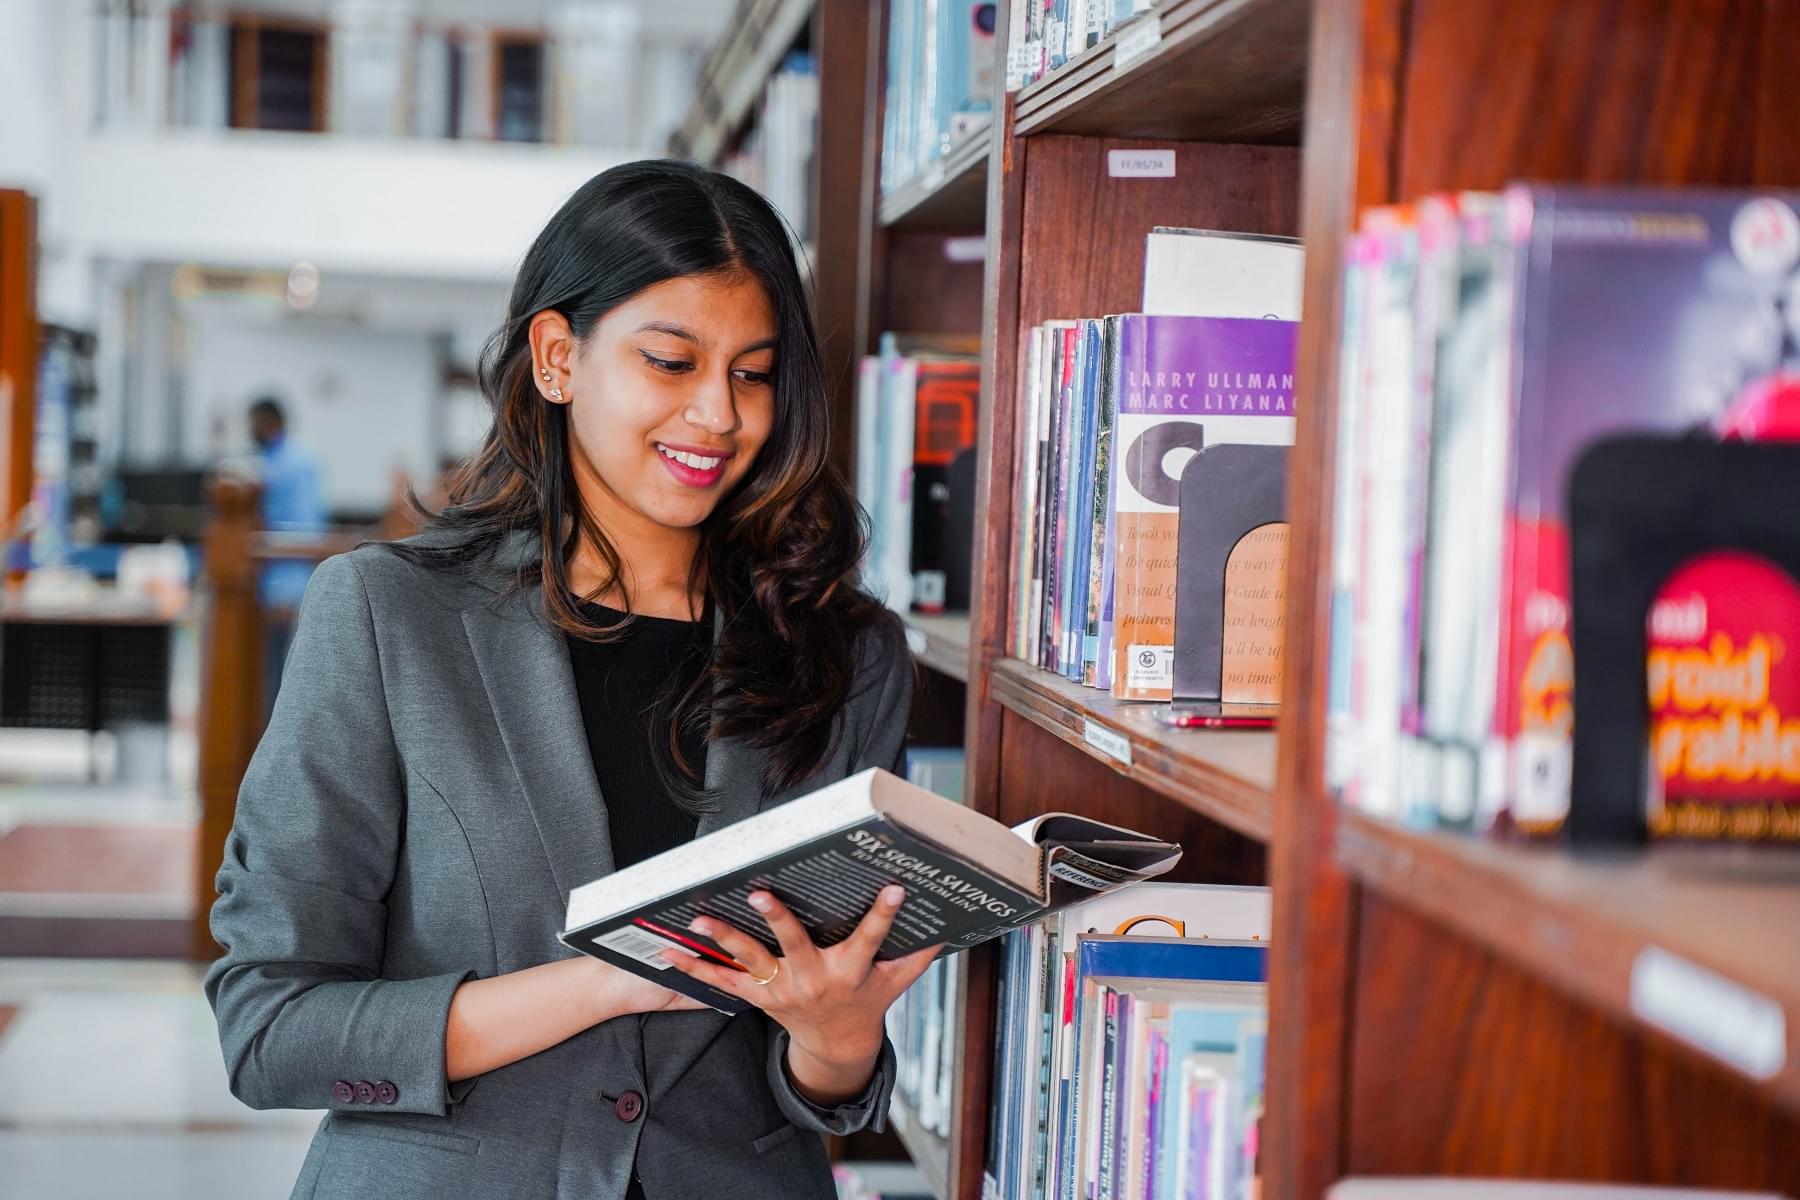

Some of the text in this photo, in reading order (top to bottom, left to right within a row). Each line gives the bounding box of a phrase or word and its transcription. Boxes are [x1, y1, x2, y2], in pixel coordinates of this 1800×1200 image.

[1129, 372, 1294, 389] LARRY ULLMAN
[1129, 392, 1190, 409] MARC
[1233, 585, 1271, 600] Guide
[1122, 612, 1172, 628] pictures
[1249, 642, 1264, 656] be
[1228, 671, 1282, 685] no time!
[846, 830, 1017, 917] SIX SIGMA SAVINGS
[851, 850, 980, 912] TO YOUR BOTTOM LINE
